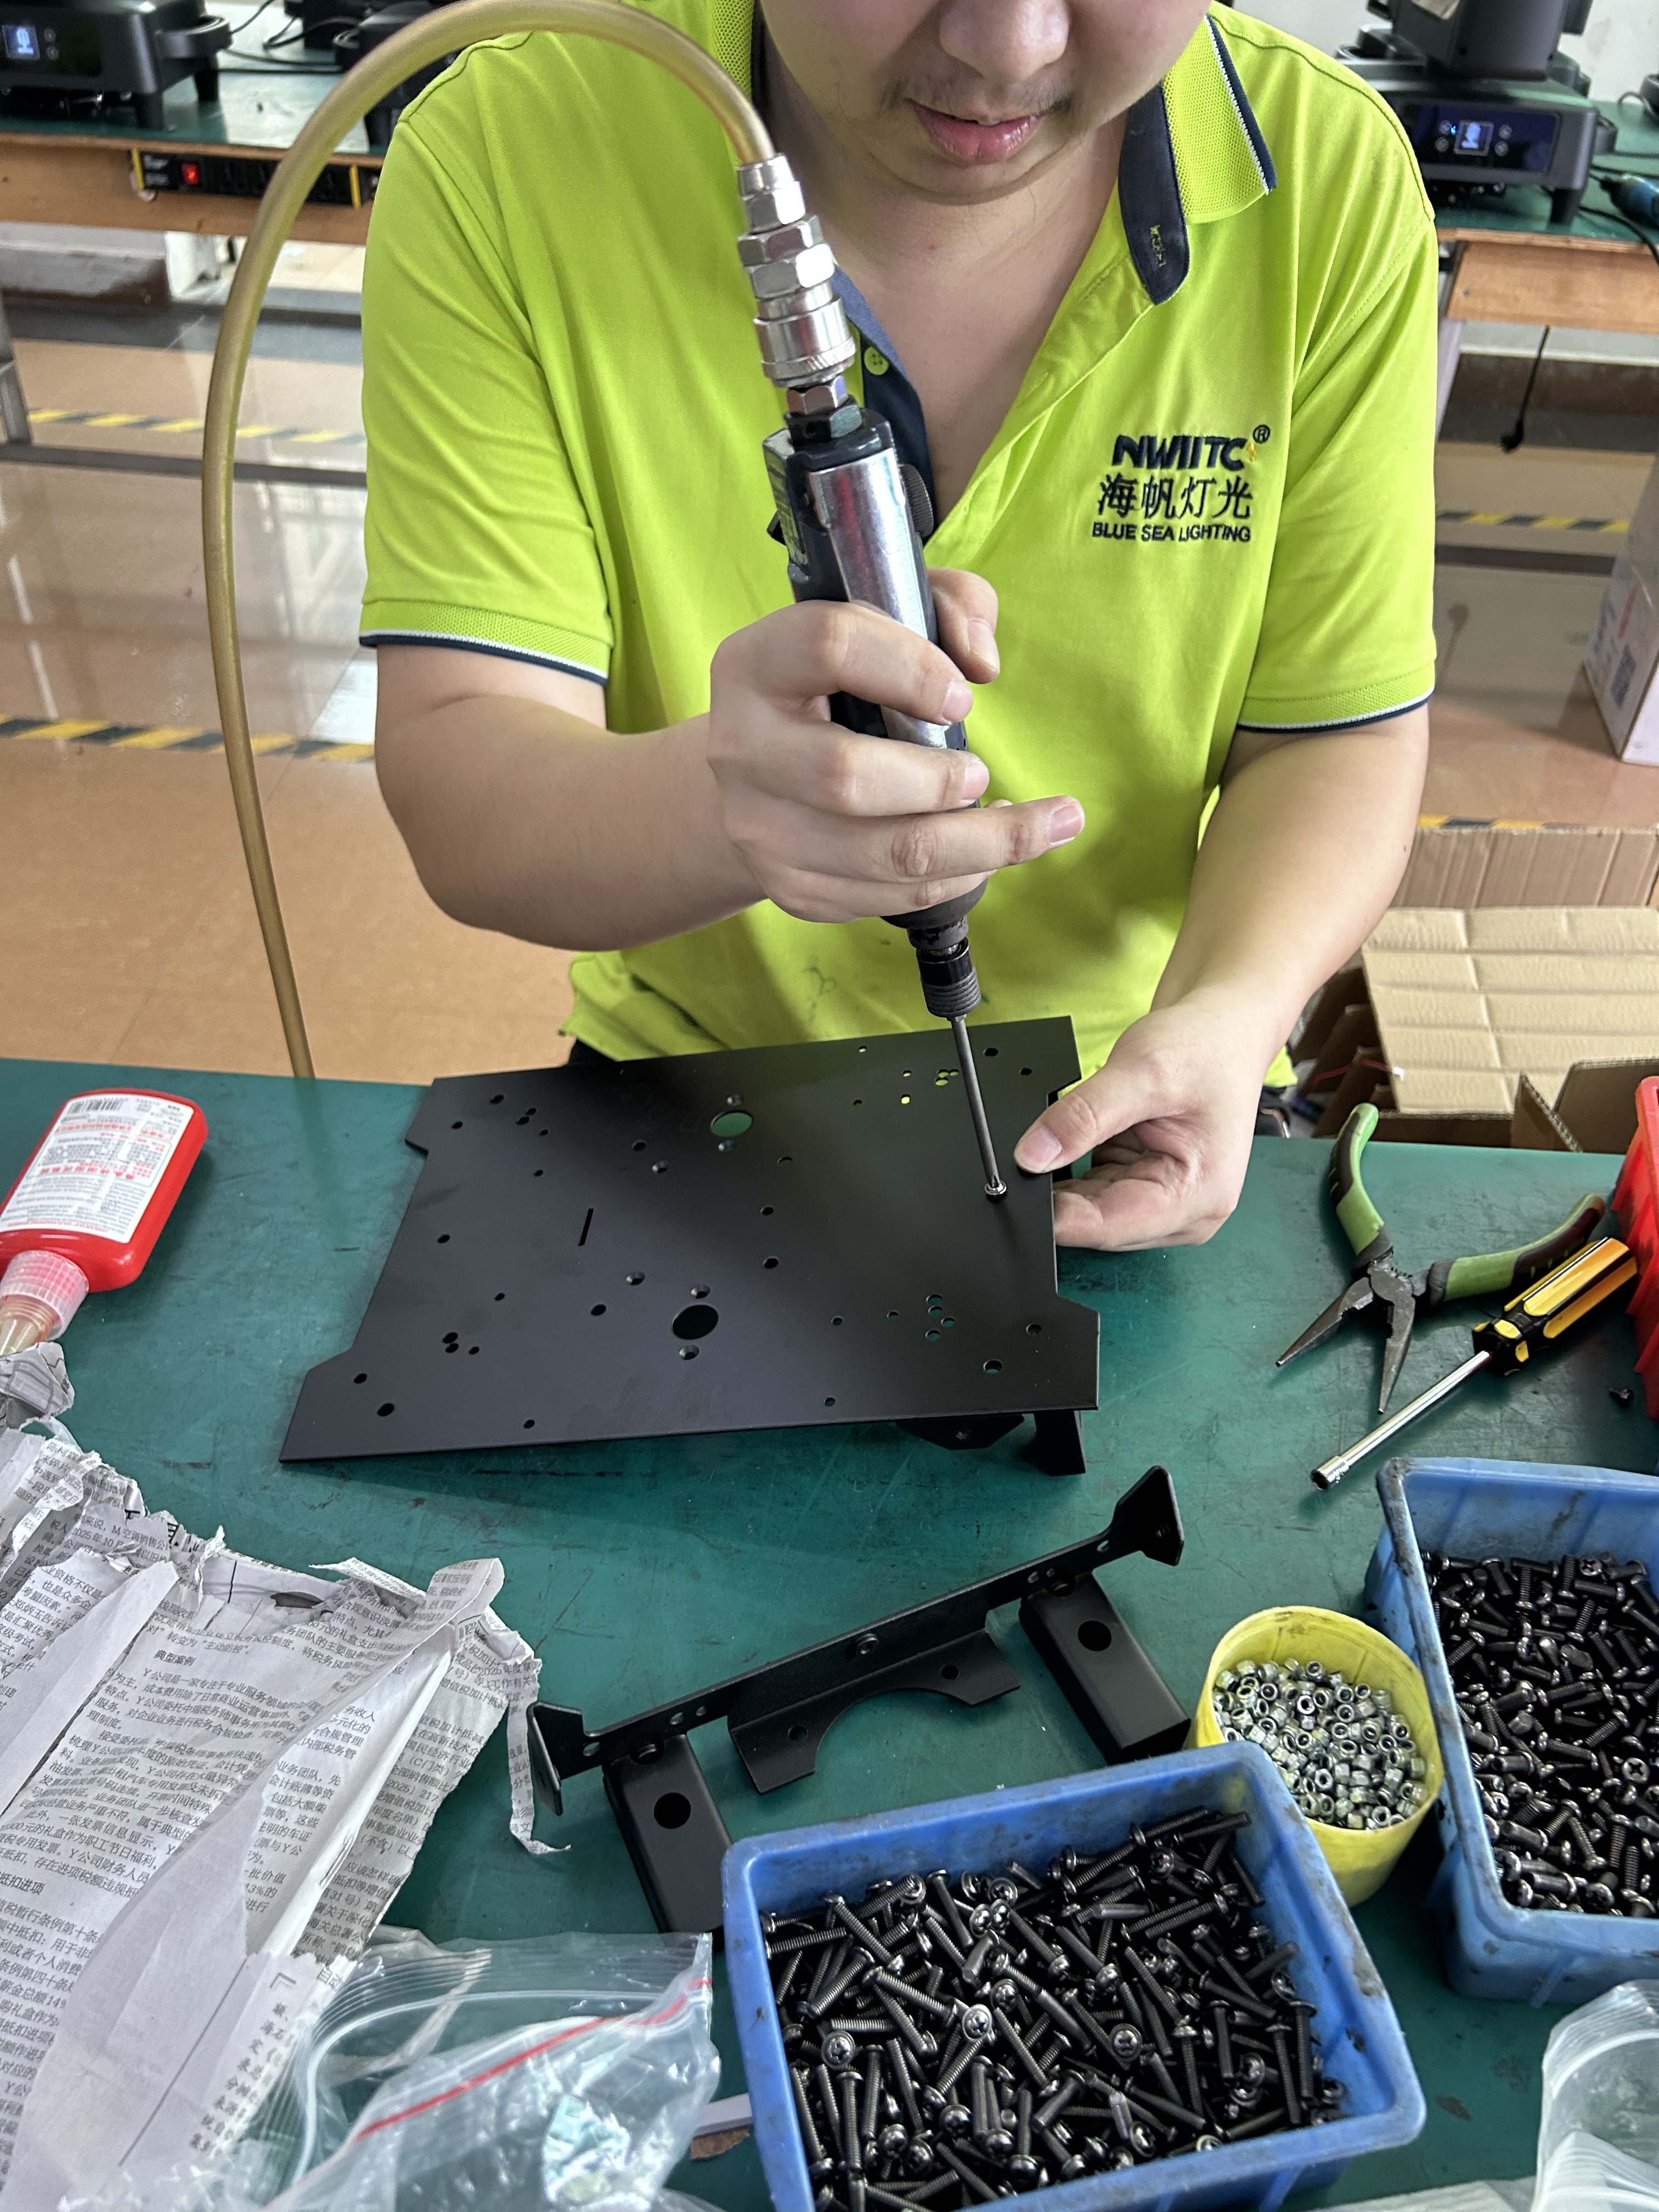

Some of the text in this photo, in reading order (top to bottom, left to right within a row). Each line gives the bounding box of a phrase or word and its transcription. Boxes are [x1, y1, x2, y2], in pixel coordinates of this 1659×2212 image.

[1098, 472, 1253, 520] 海帆灯光
[1092, 521, 1251, 543] BLUE SEA LIGHTING
[154, 1650, 197, 1667] 典型案例
